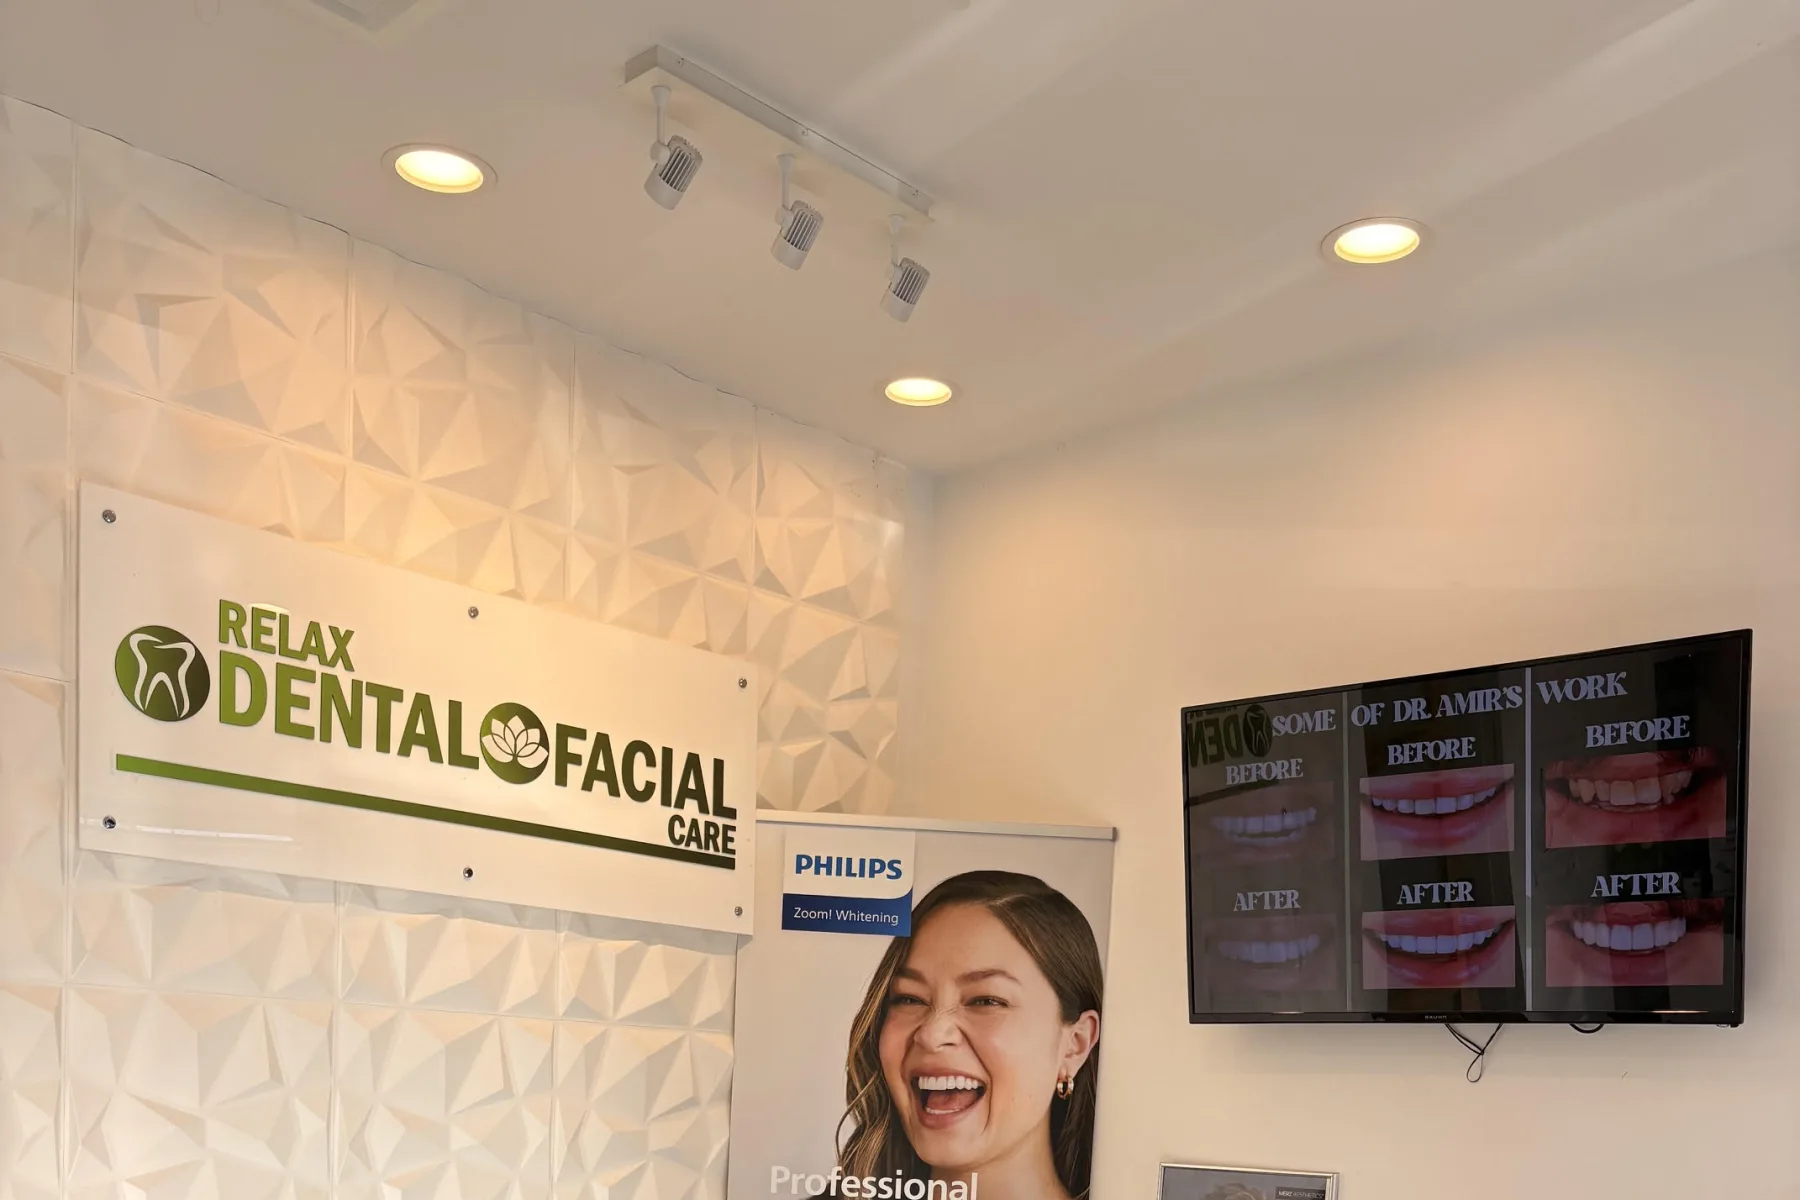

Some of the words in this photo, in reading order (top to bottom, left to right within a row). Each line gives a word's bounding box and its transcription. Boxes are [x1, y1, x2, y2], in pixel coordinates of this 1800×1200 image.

[219, 598, 355, 672] RELAX
[1271, 708, 1337, 738] SOME
[1351, 702, 1385, 727] OF
[1393, 699, 1432, 723] DR.
[1436, 685, 1523, 719] AMIR'S
[1537, 671, 1628, 706] WORK
[219, 650, 480, 769] DENTAL
[554, 722, 737, 820] FACIAL
[1586, 715, 1690, 749] BEFORE
[1387, 736, 1476, 766] BEFORE
[1225, 758, 1304, 786] BEFORE
[668, 815, 736, 857] CARE
[795, 854, 903, 880] PHILIPS
[1397, 881, 1475, 905] AFTER
[1591, 871, 1681, 898] AFTER
[1233, 888, 1300, 912] AFTER
[793, 907, 832, 920] Zoom!
[835, 909, 899, 926] Whitening
